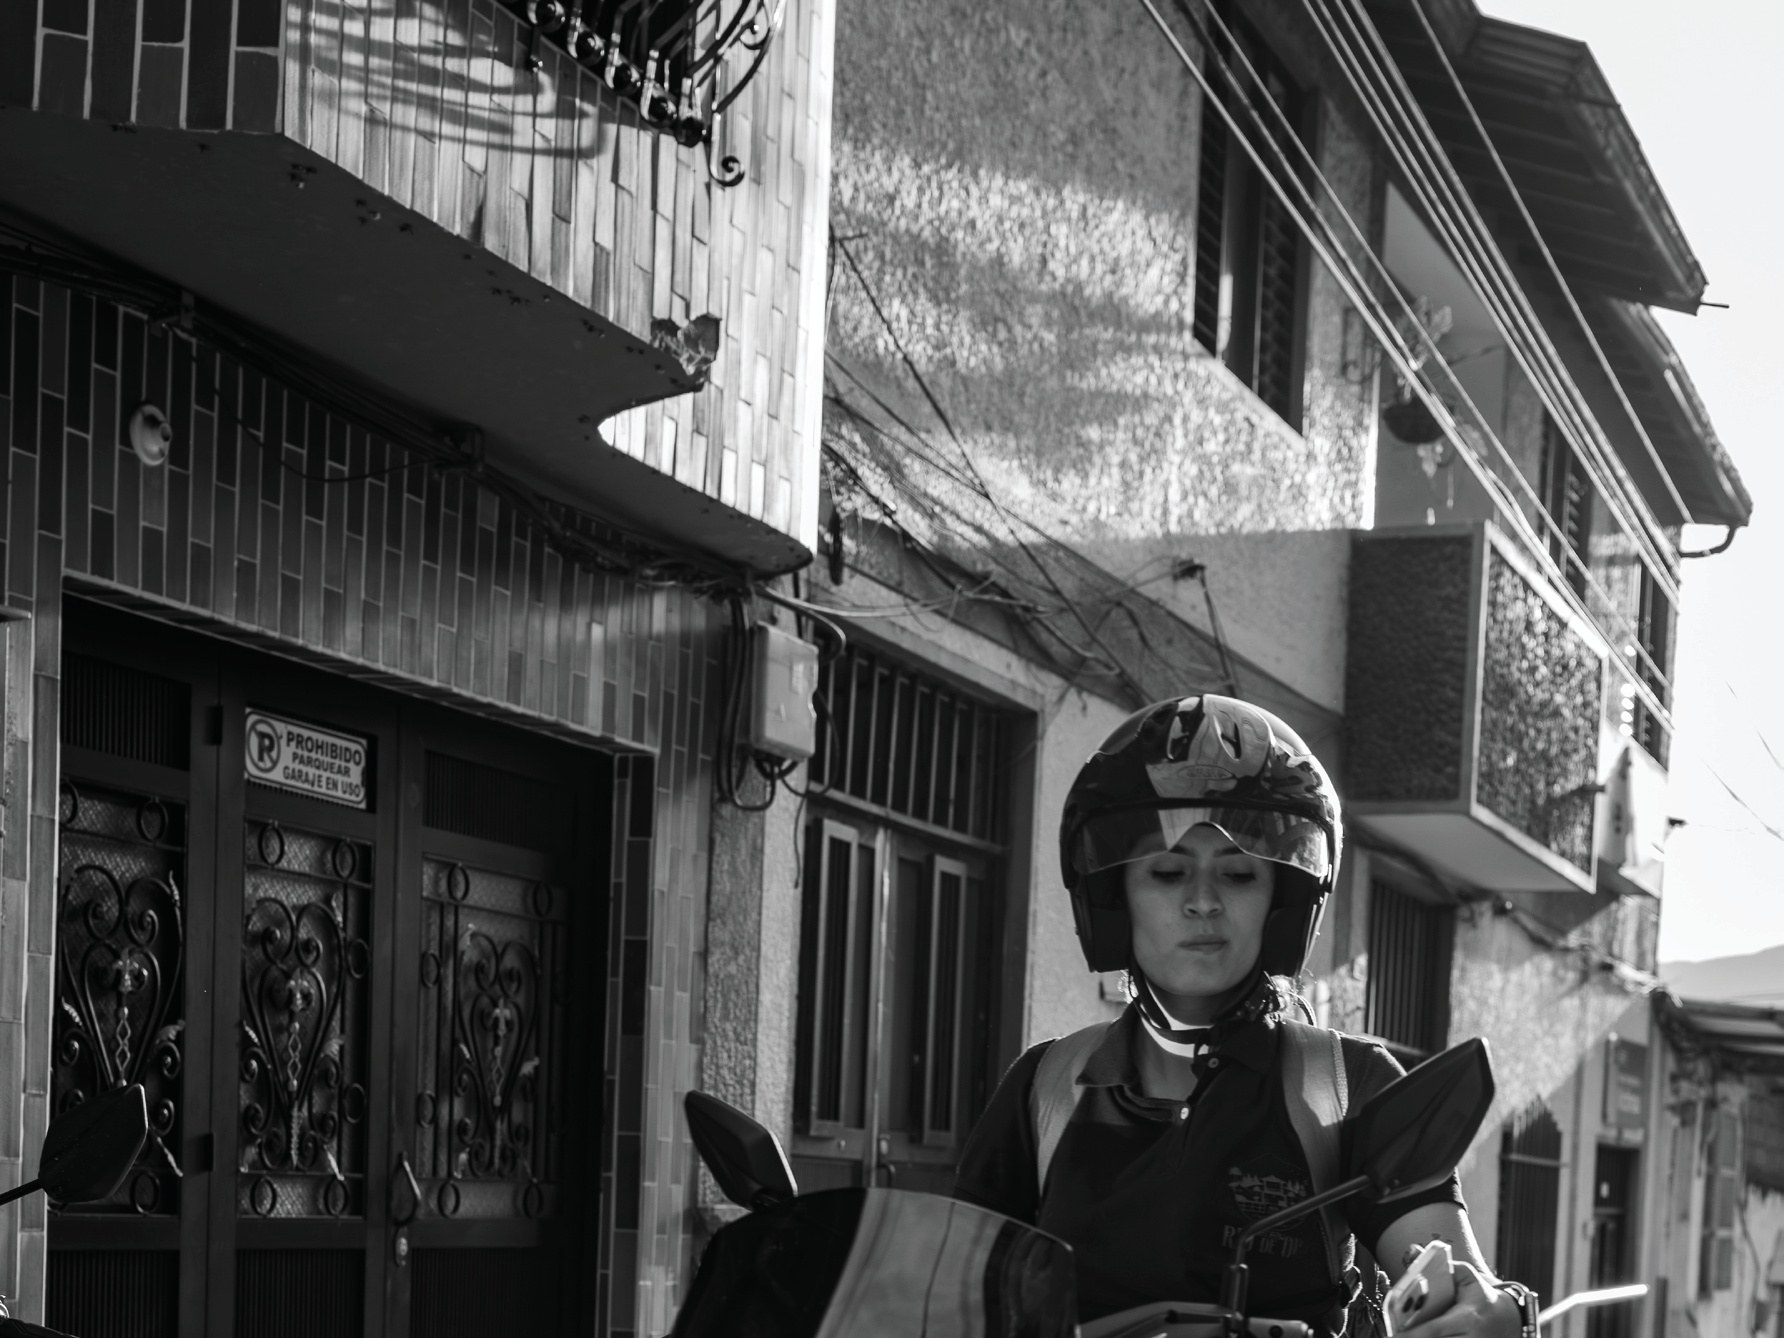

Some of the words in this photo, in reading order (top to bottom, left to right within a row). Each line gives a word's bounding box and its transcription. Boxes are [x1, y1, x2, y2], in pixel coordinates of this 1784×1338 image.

[286, 731, 362, 766] PROHIBIDO
[292, 751, 351, 777] PARQUEAR
[282, 766, 323, 788] GARAJE
[325, 776, 339, 793] EN
[341, 781, 361, 798] USO
